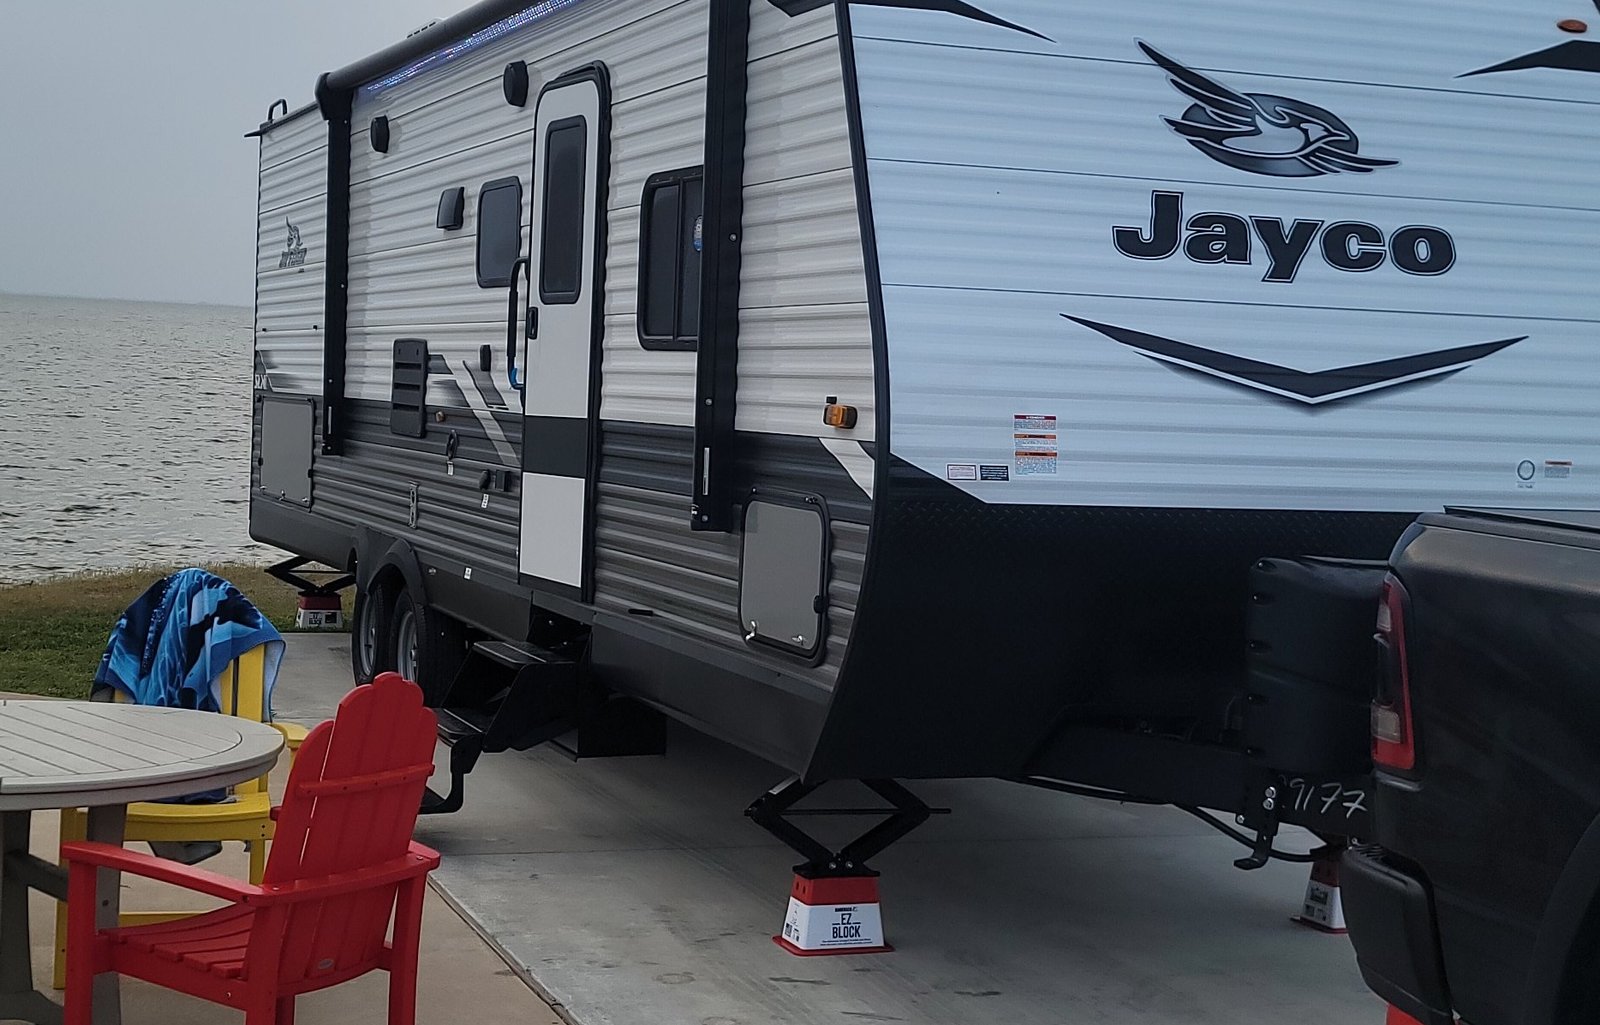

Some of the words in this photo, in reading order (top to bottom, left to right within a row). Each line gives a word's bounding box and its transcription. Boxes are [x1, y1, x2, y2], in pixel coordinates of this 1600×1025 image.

[1112, 190, 1457, 283] Jayco
[1289, 777, 1369, 819] 9177
[832, 925, 861, 939] BLOCK
[841, 913, 852, 925] EZ
